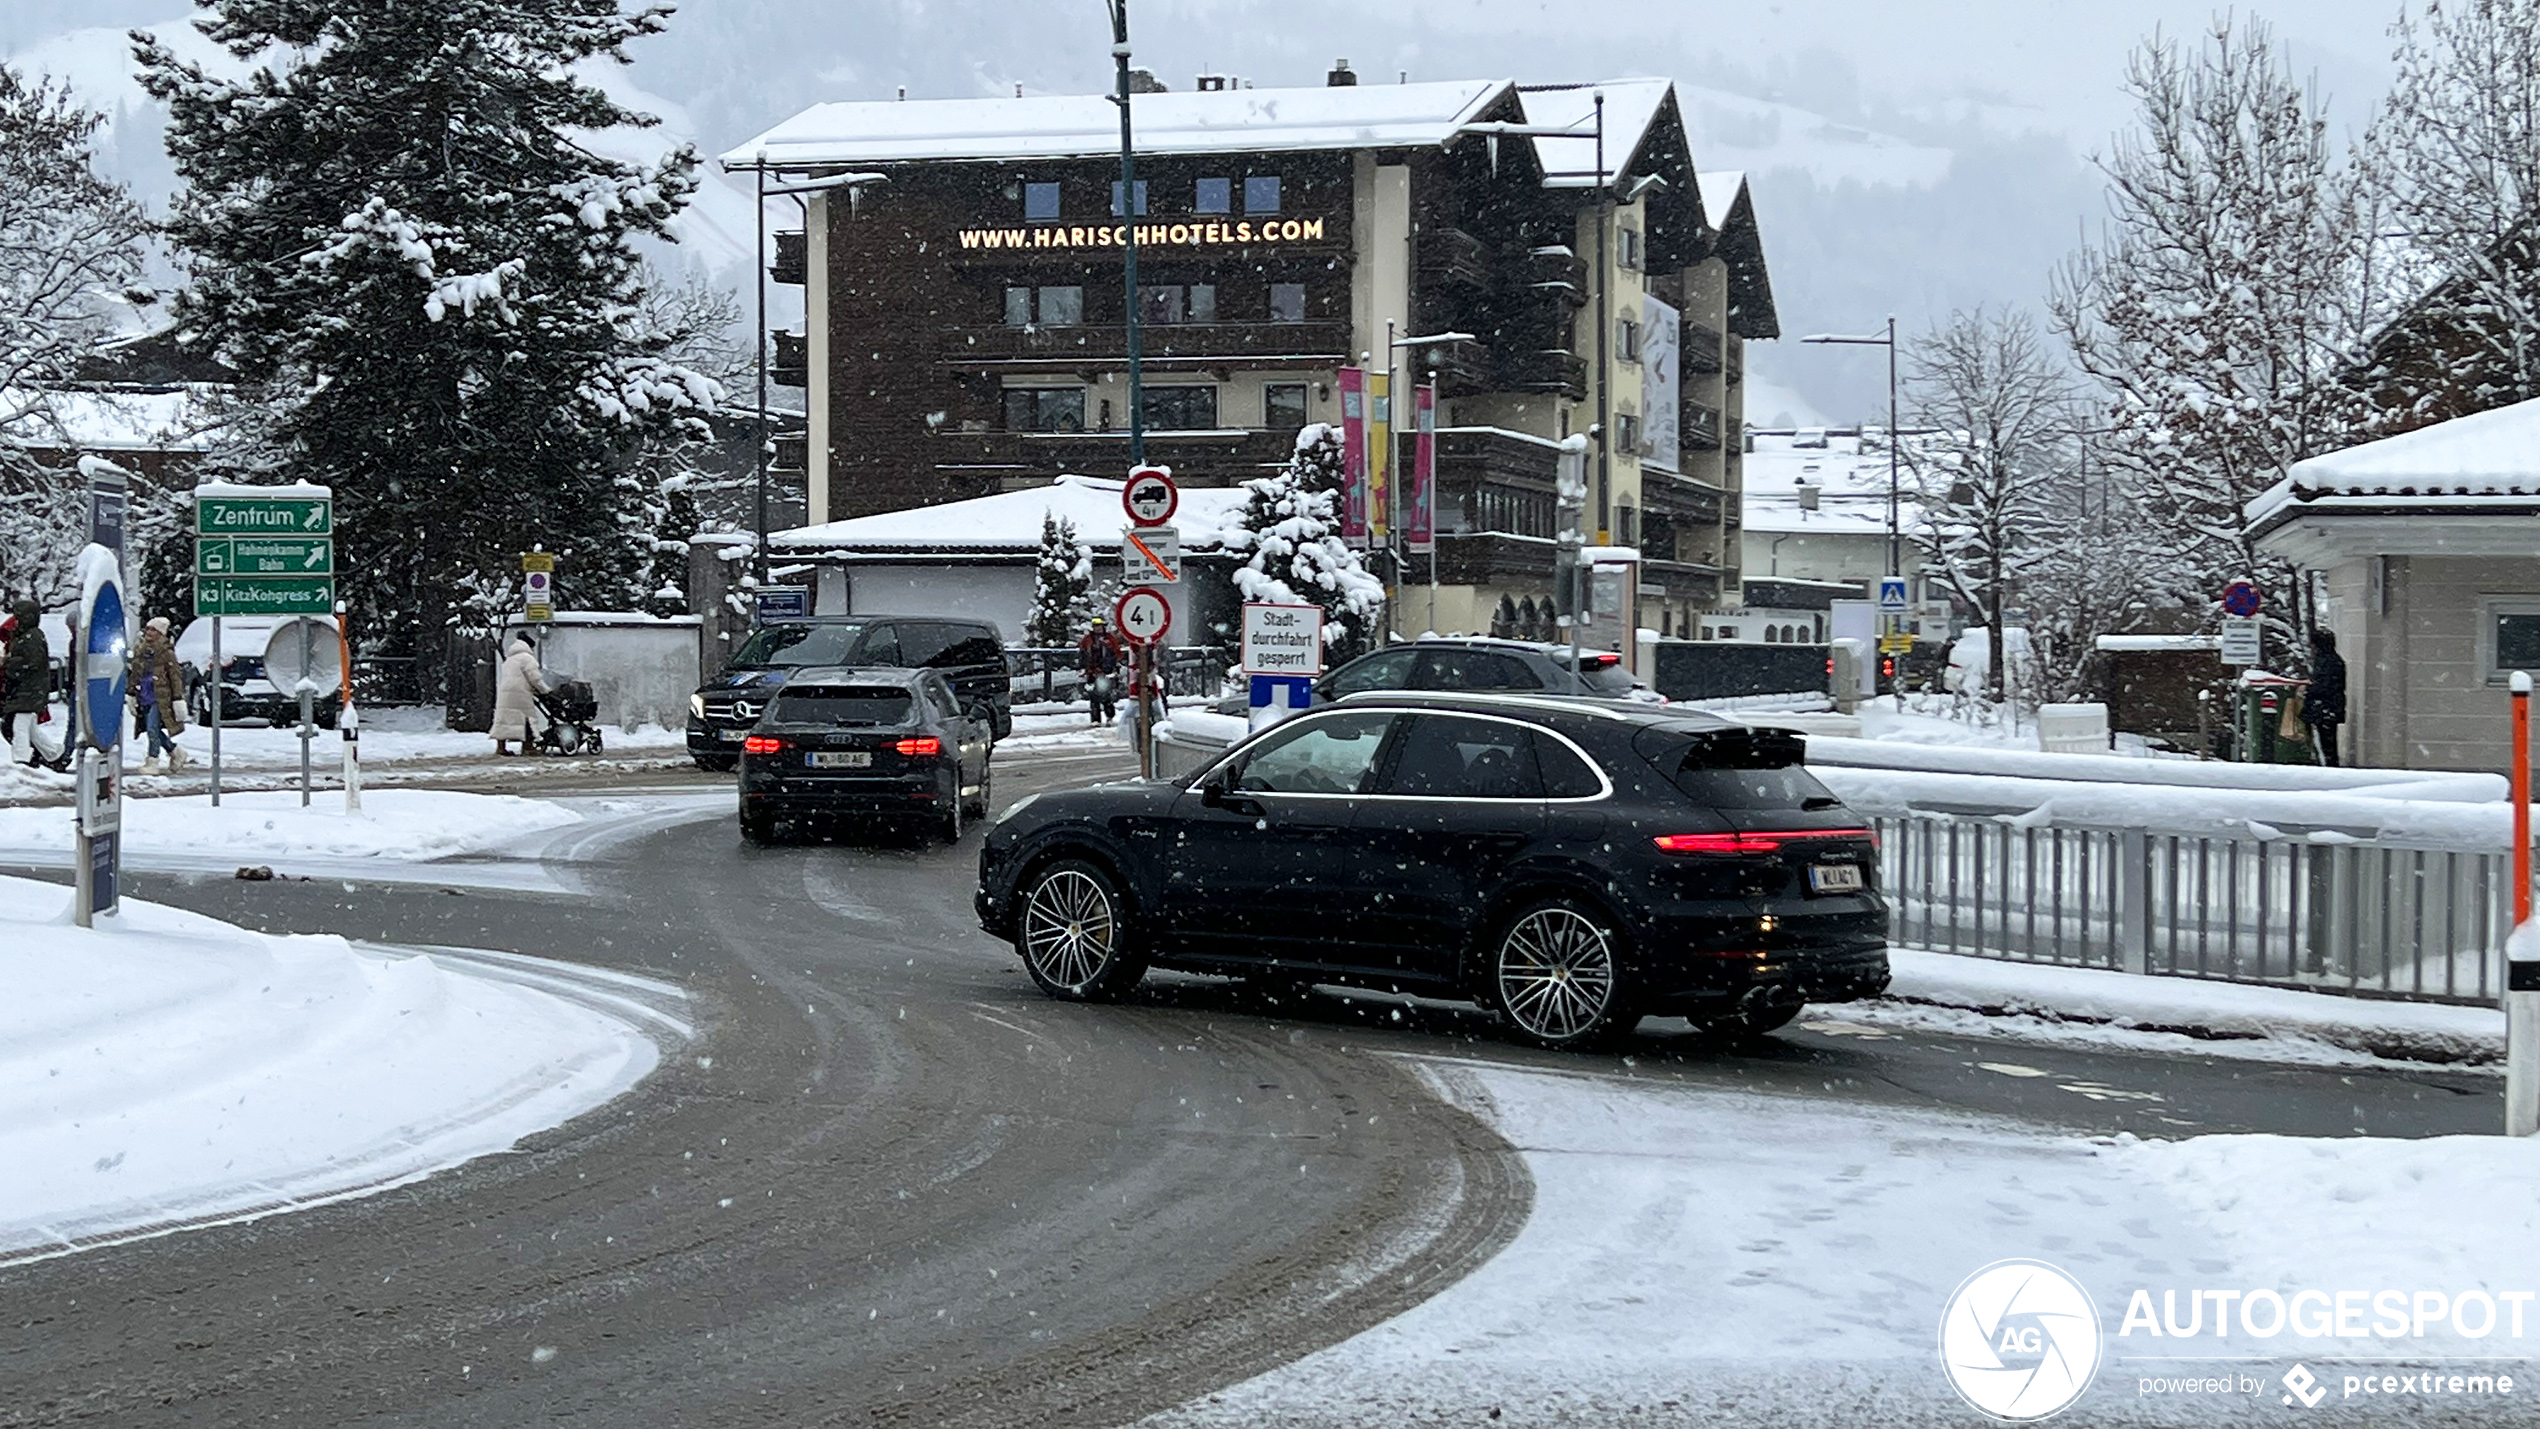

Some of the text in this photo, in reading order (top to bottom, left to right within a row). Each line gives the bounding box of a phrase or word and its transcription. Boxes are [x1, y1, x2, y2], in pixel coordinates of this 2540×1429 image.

[959, 219, 1323, 248] WWW.HARISCHHOTELS.COM
[212, 505, 295, 525] Zentrum
[259, 558, 285, 571] Bahn
[201, 587, 311, 604] K3 KitzKongress
[1263, 611, 1301, 627] Stadt-
[1252, 631, 1313, 647] durchfahrt
[1257, 651, 1306, 668] gesperrt
